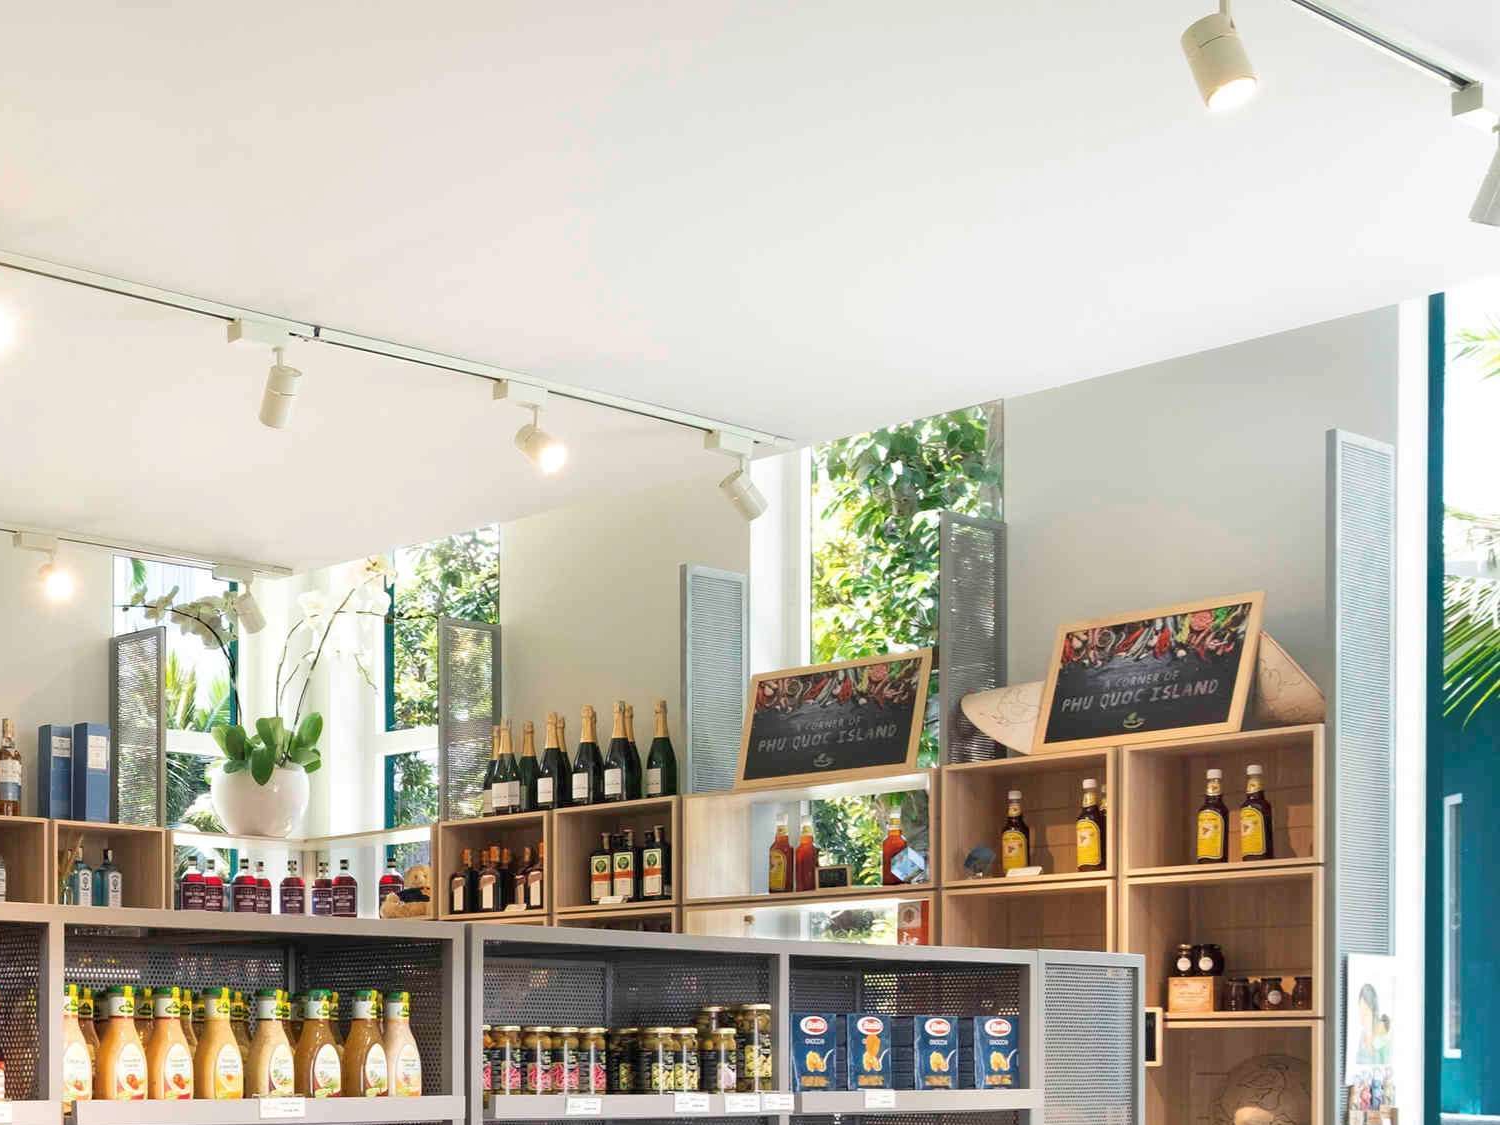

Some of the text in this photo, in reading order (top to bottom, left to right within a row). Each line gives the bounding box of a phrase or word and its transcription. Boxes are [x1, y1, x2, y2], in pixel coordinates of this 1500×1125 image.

[1115, 672, 1159, 686] CORNER
[1061, 678, 1219, 712] PHU QUOC ISLAND
[804, 719, 845, 730] CORNER
[757, 723, 898, 753] PHU QUOC ISLAND
